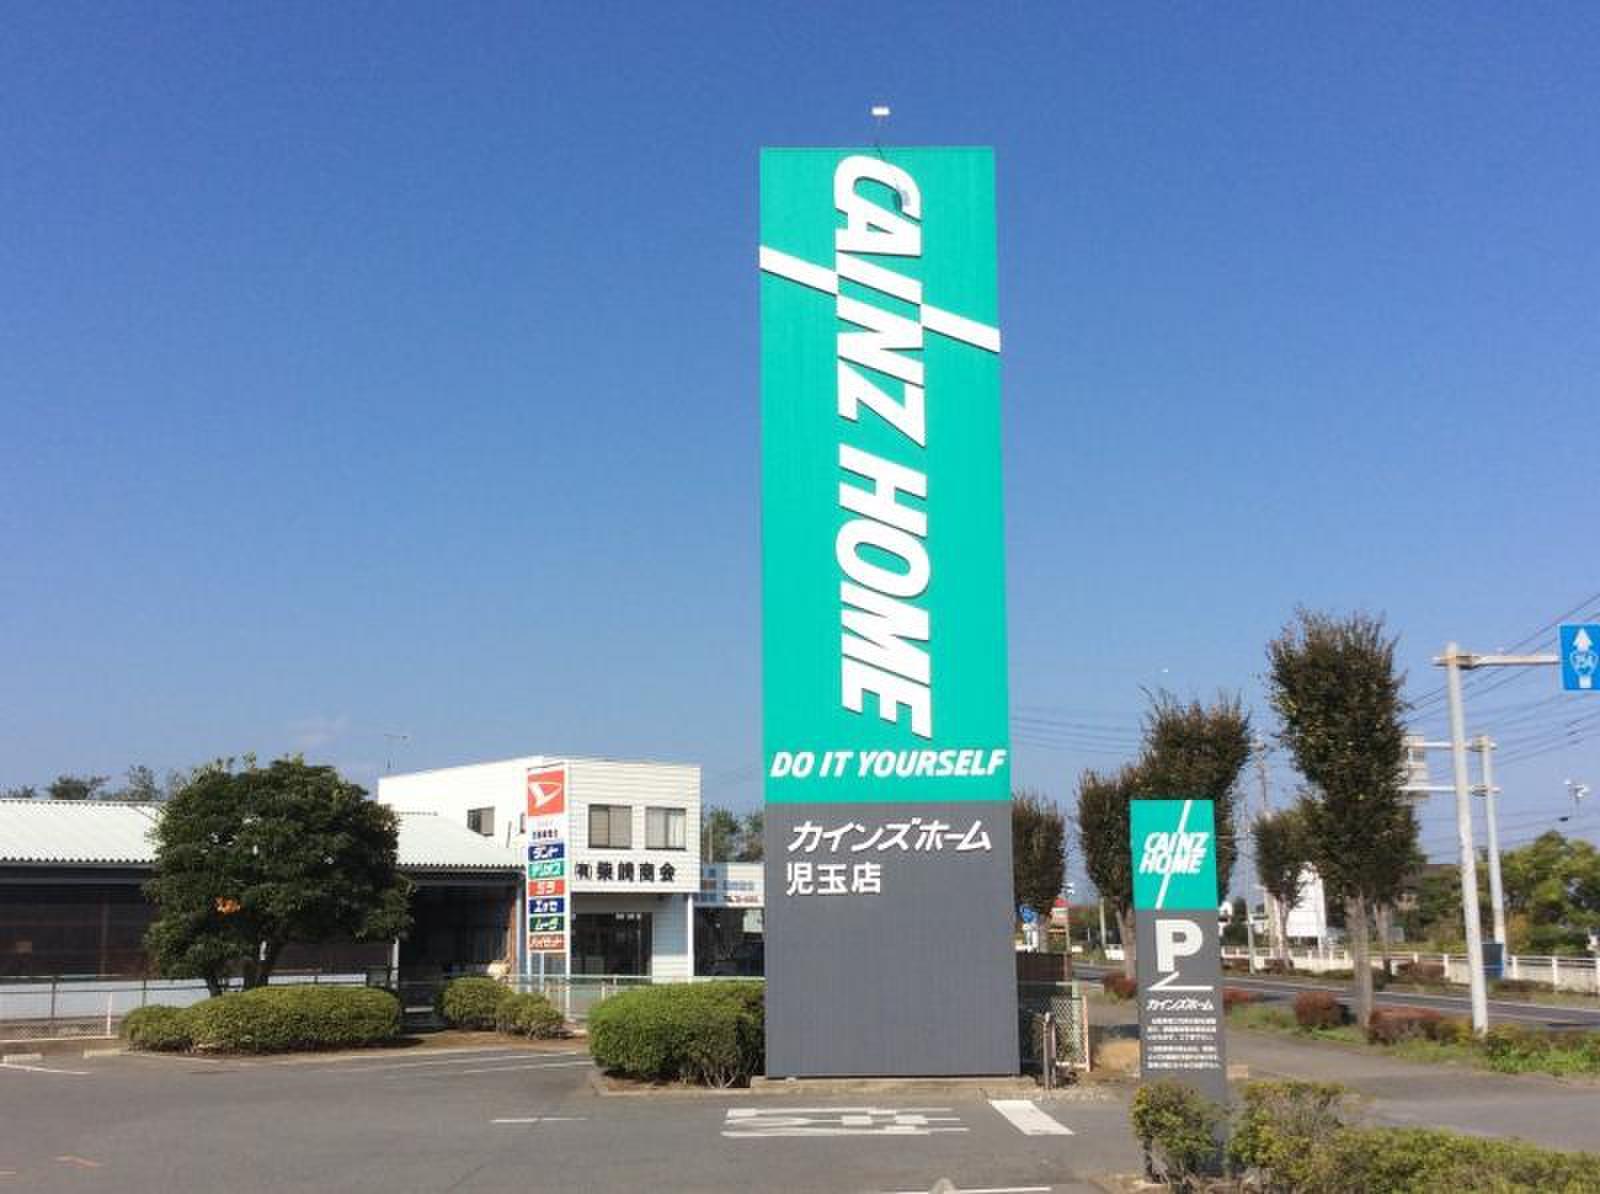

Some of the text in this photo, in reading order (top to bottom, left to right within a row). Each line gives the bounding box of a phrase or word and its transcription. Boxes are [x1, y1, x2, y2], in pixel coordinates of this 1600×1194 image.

[833, 154, 932, 739] CAINZ HOME
[770, 749, 1007, 778] DO IT YOURSELF
[788, 817, 993, 853] カインズホーム
[1143, 832, 1210, 850] CAINZ
[785, 861, 882, 897] 児玉店
[1139, 847, 1206, 875] HOME
[1154, 918, 1204, 973] P
